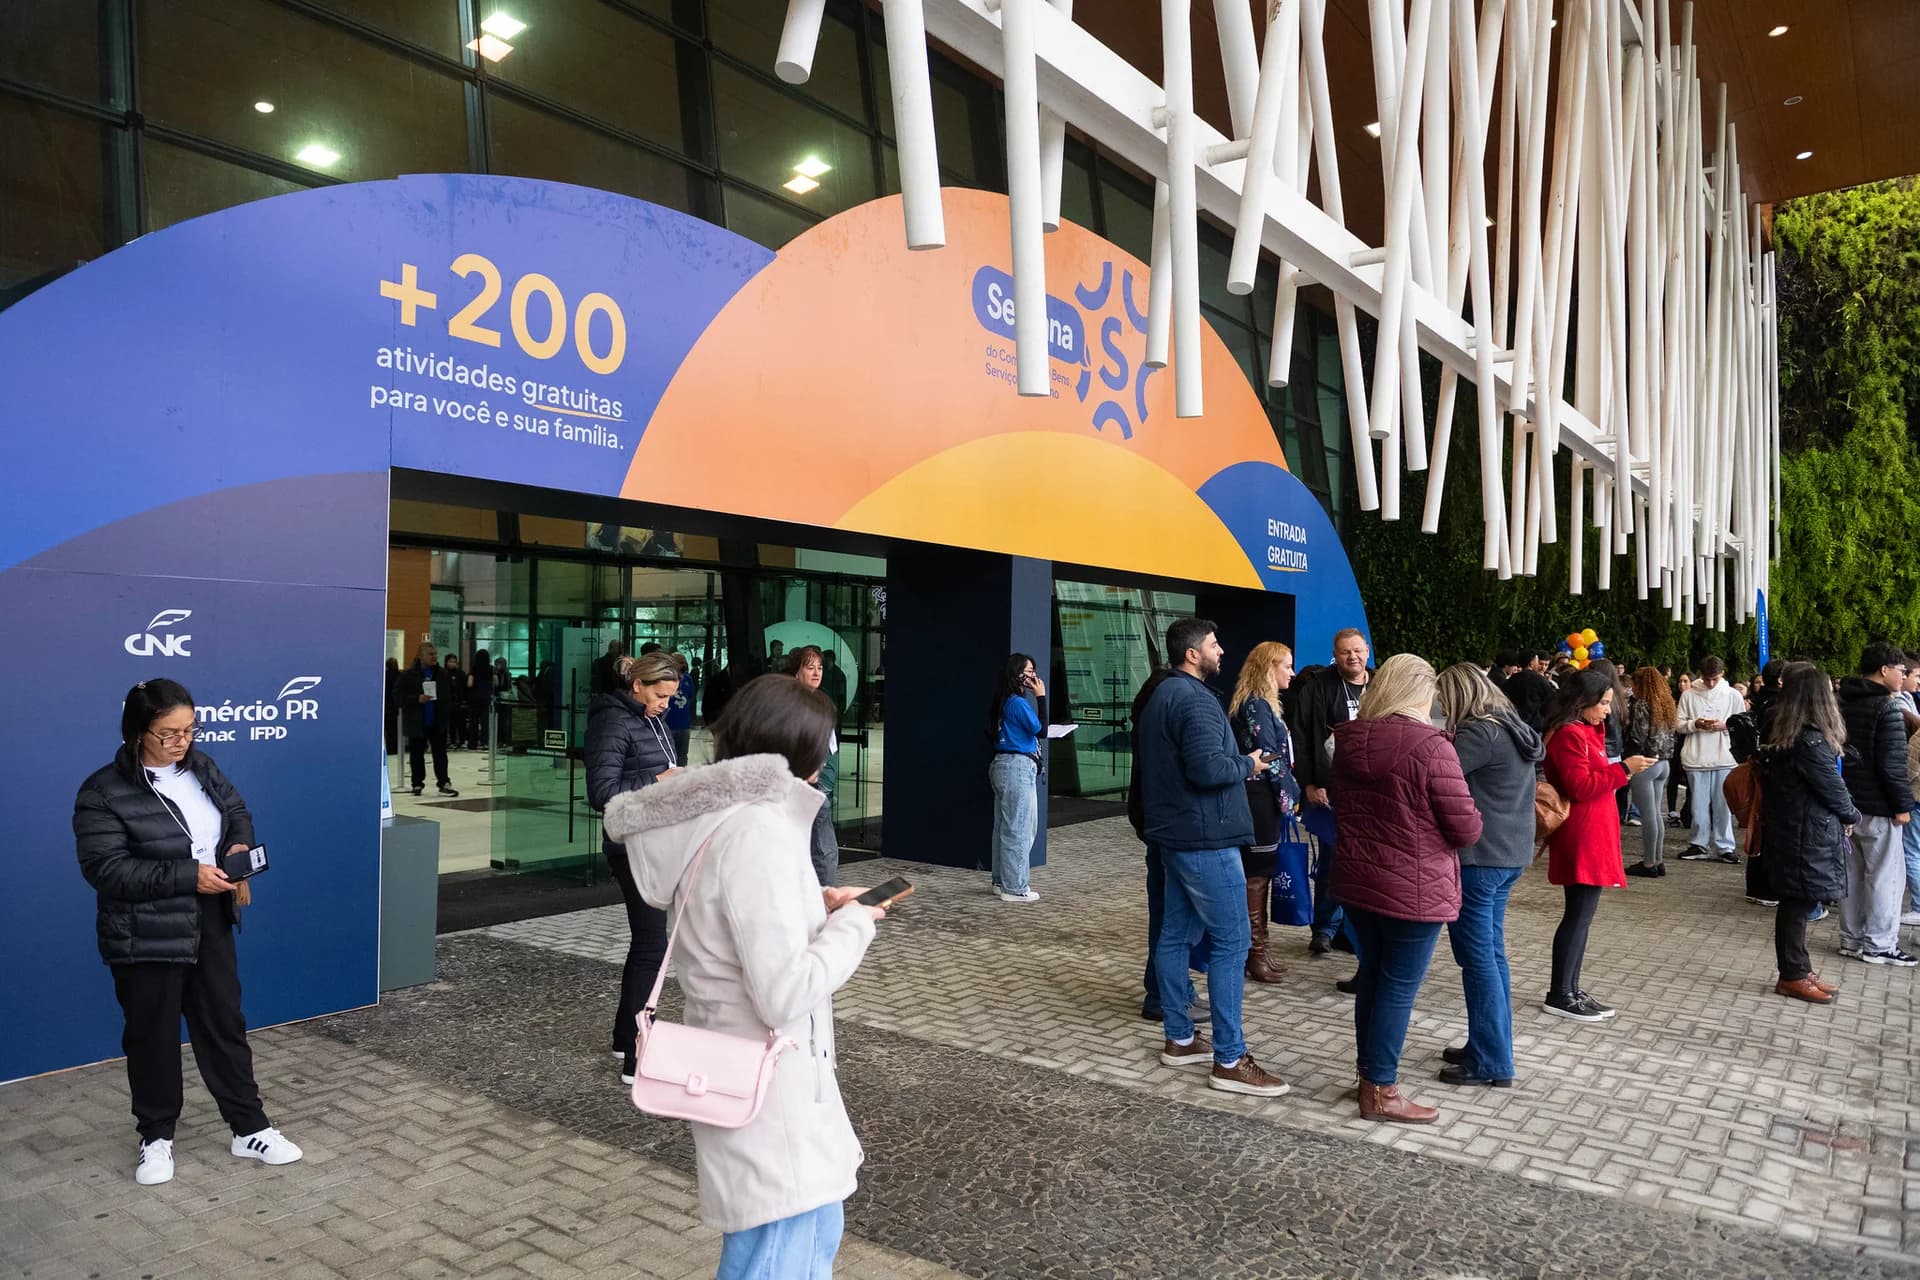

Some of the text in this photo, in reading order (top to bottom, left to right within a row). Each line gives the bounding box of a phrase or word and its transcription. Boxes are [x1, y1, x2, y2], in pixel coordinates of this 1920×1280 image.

[379, 253, 627, 375] +200
[986, 282, 1073, 351] Sena
[986, 344, 998, 359] do
[376, 347, 623, 418] atividades gratuitas
[985, 362, 1018, 386] Serviço
[370, 385, 625, 450] para você e sua família.
[1267, 518, 1307, 545] ENTRADA
[1267, 545, 1308, 570] GRATUITA
[124, 633, 192, 657] CNC
[194, 699, 319, 722] mércio PR
[193, 725, 288, 742] enac IFPD
